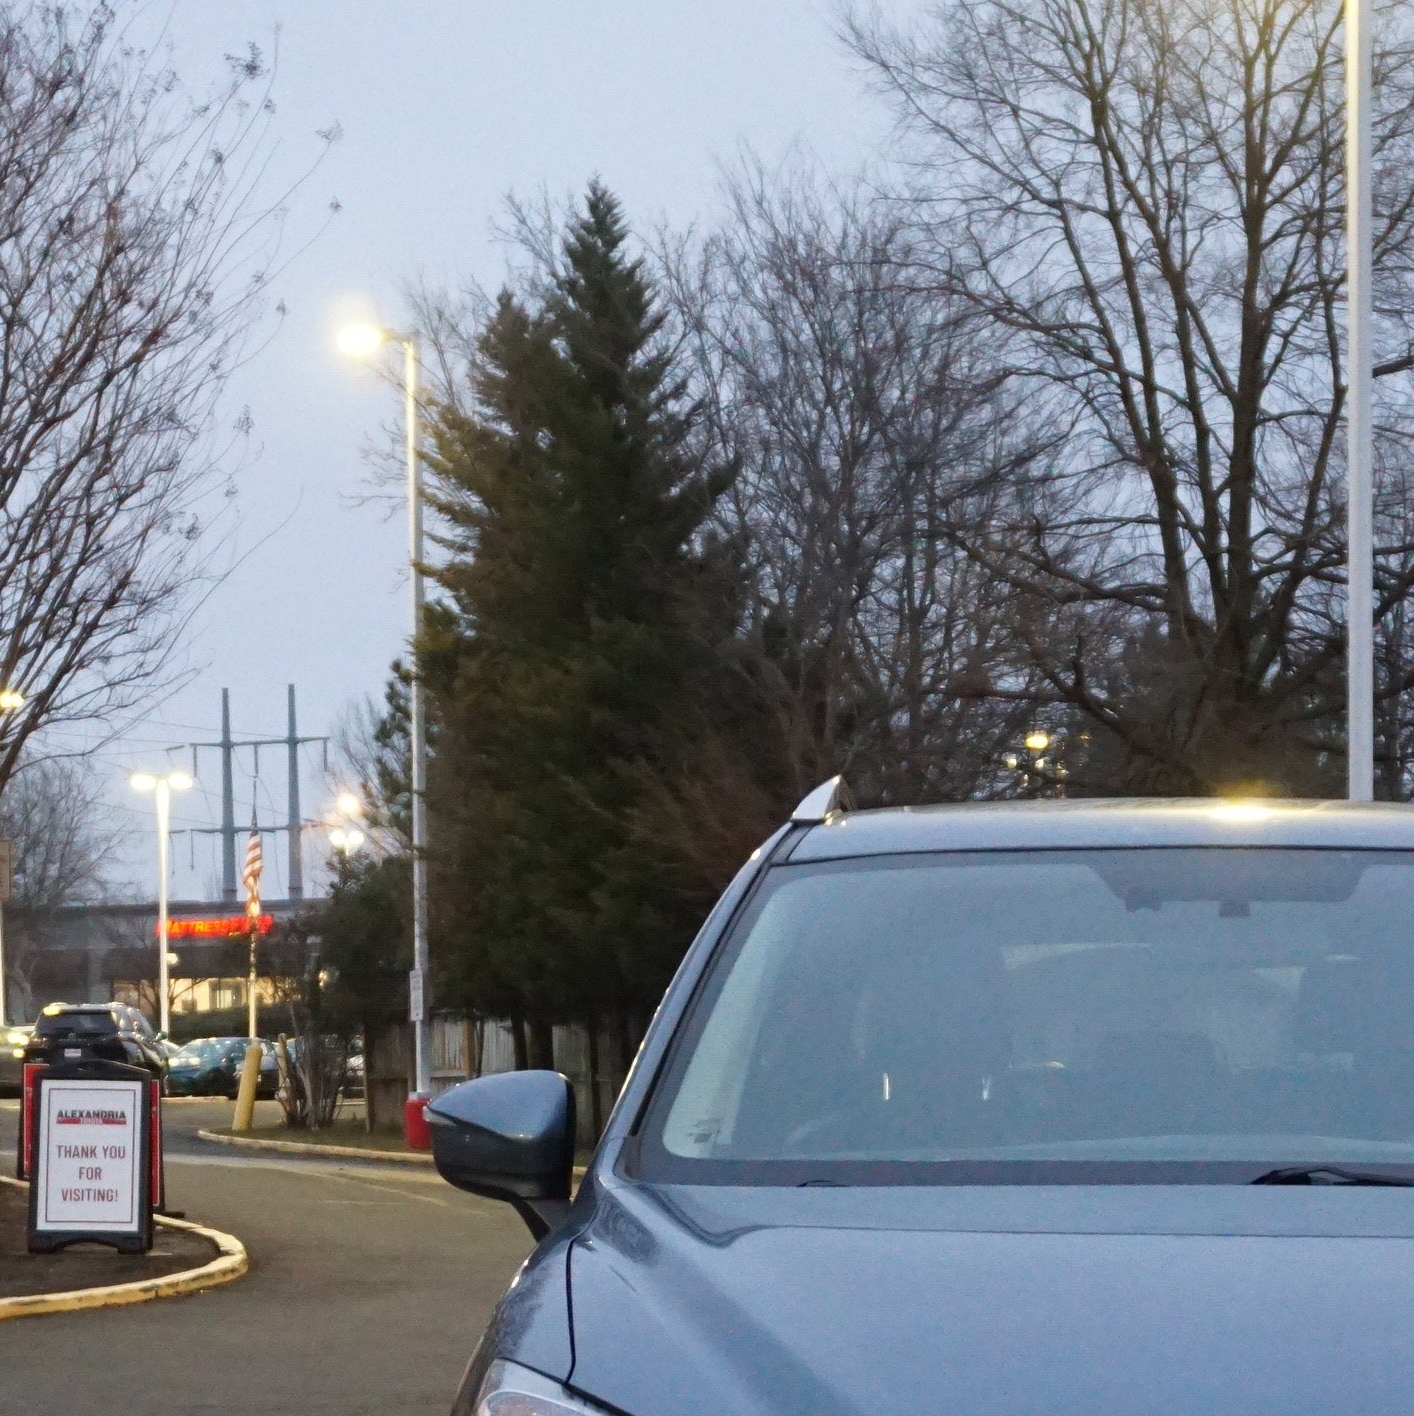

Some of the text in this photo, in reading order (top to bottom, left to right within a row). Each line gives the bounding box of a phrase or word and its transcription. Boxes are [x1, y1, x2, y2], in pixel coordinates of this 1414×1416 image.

[57, 1110, 126, 1119] ALEXANDRIA
[57, 1145, 126, 1159] THANK YOU
[78, 1166, 102, 1180] FOR
[61, 1188, 119, 1202] VISITING!
